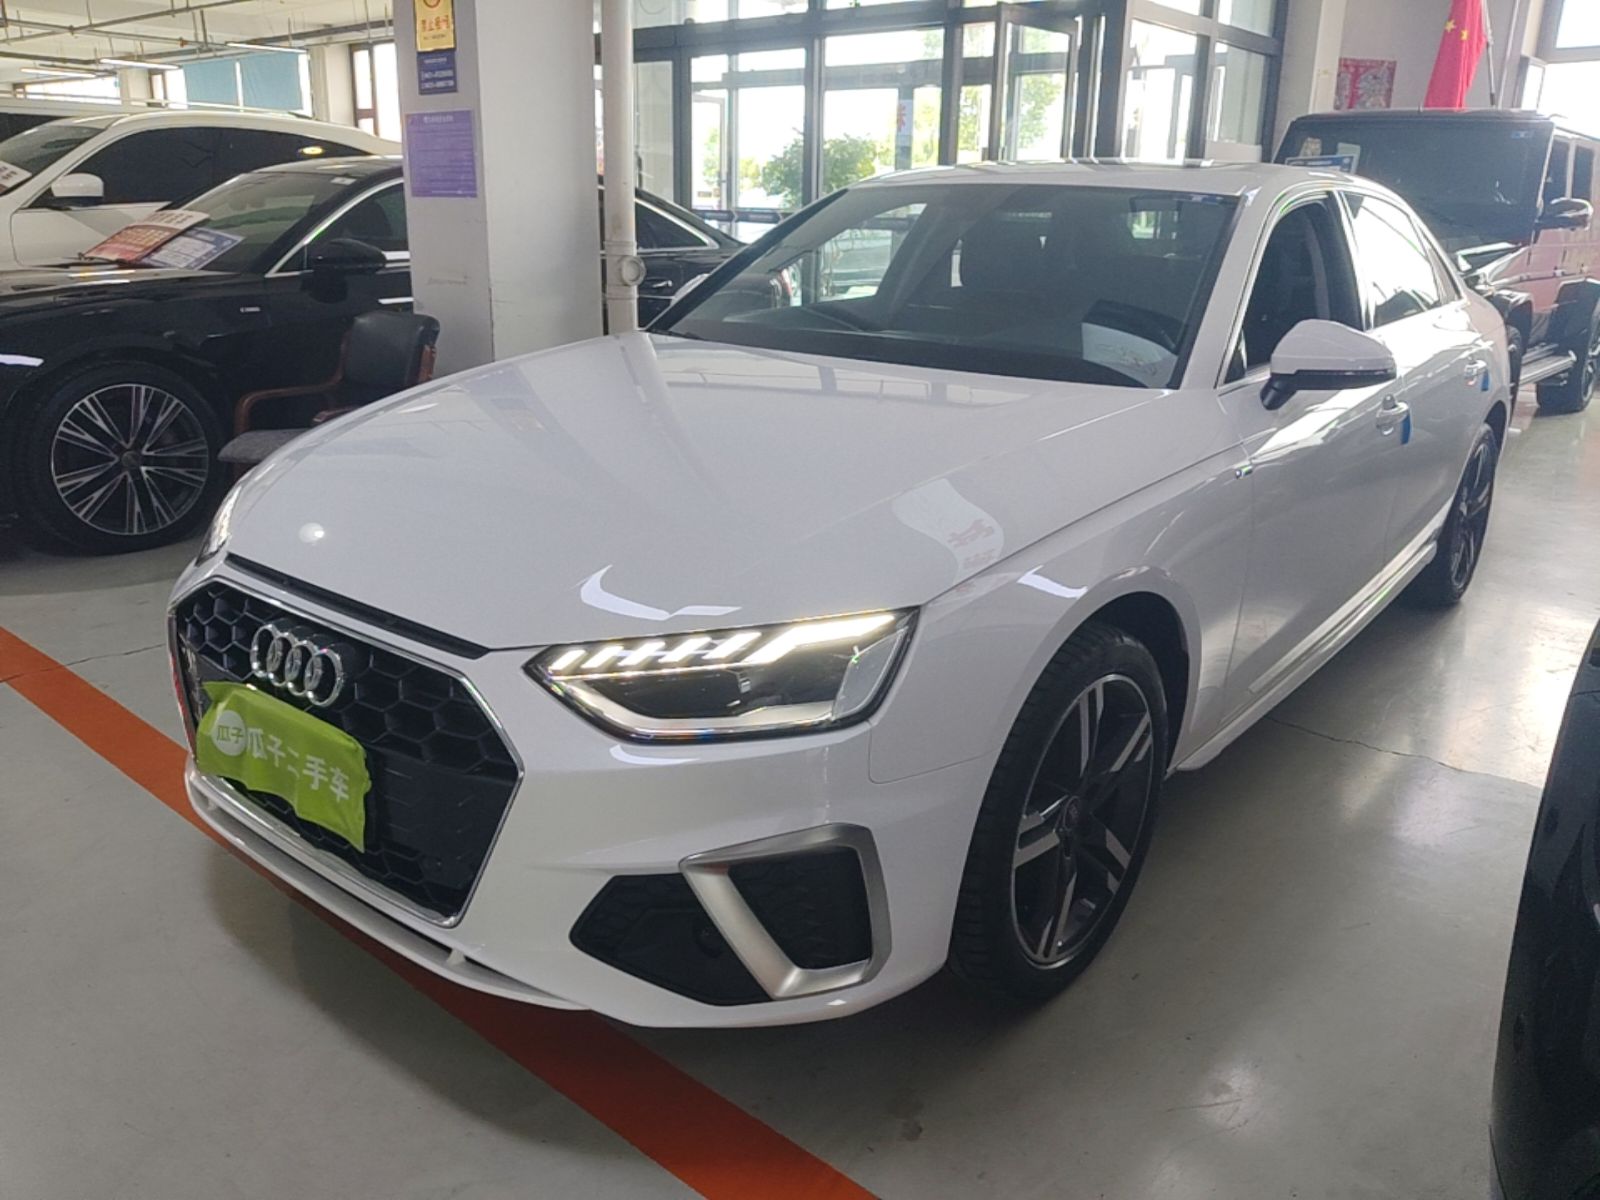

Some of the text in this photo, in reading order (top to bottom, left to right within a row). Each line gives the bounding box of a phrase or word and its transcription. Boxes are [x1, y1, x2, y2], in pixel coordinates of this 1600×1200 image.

[217, 726, 243, 744] 瓜子
[249, 728, 349, 801] 瓜子二手车
